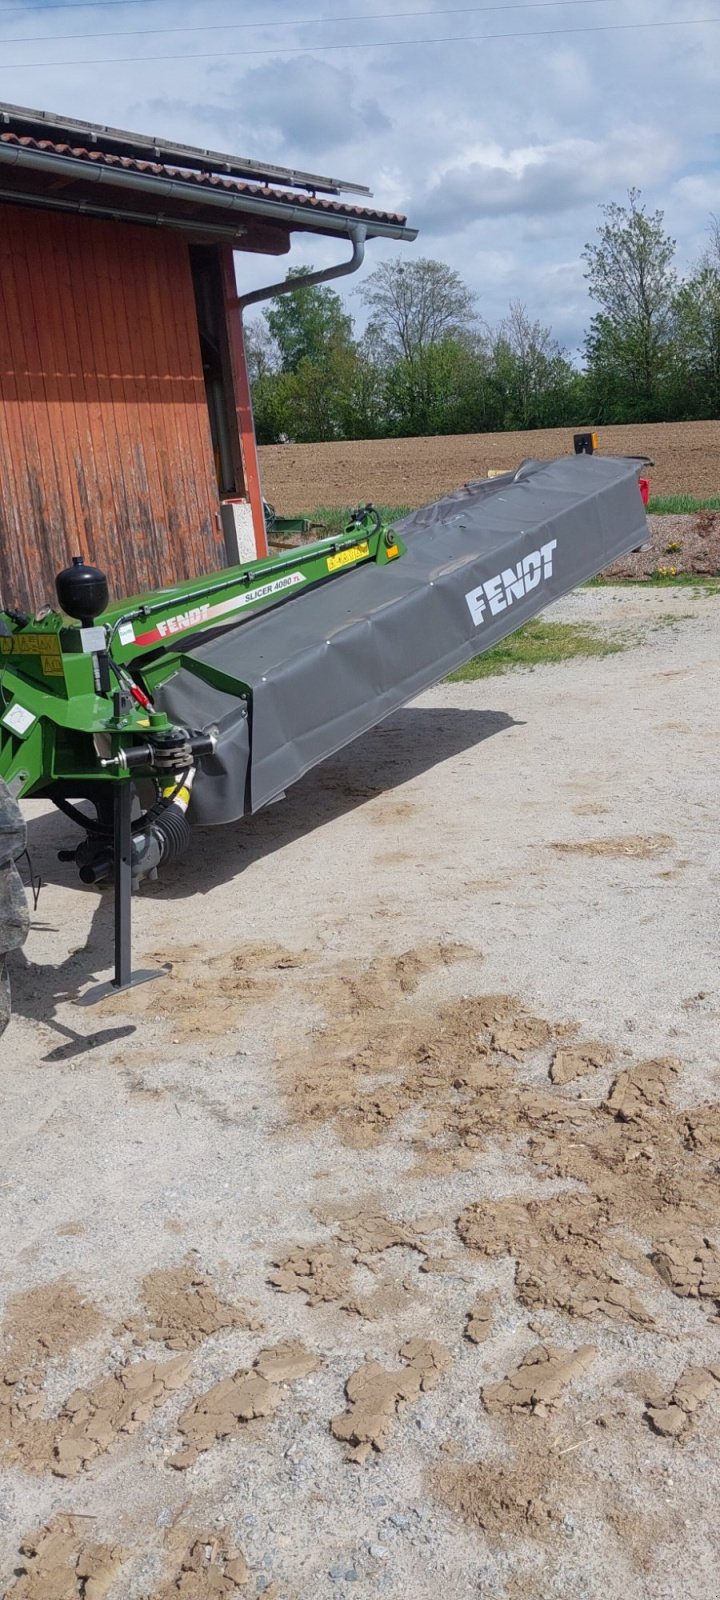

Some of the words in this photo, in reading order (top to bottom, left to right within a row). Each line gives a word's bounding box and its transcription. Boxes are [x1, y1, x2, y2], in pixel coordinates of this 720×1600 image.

[156, 603, 210, 637] FENDT
[245, 585, 273, 602] SLICER
[274, 577, 292, 590] 4080
[465, 539, 557, 627] FENDT
